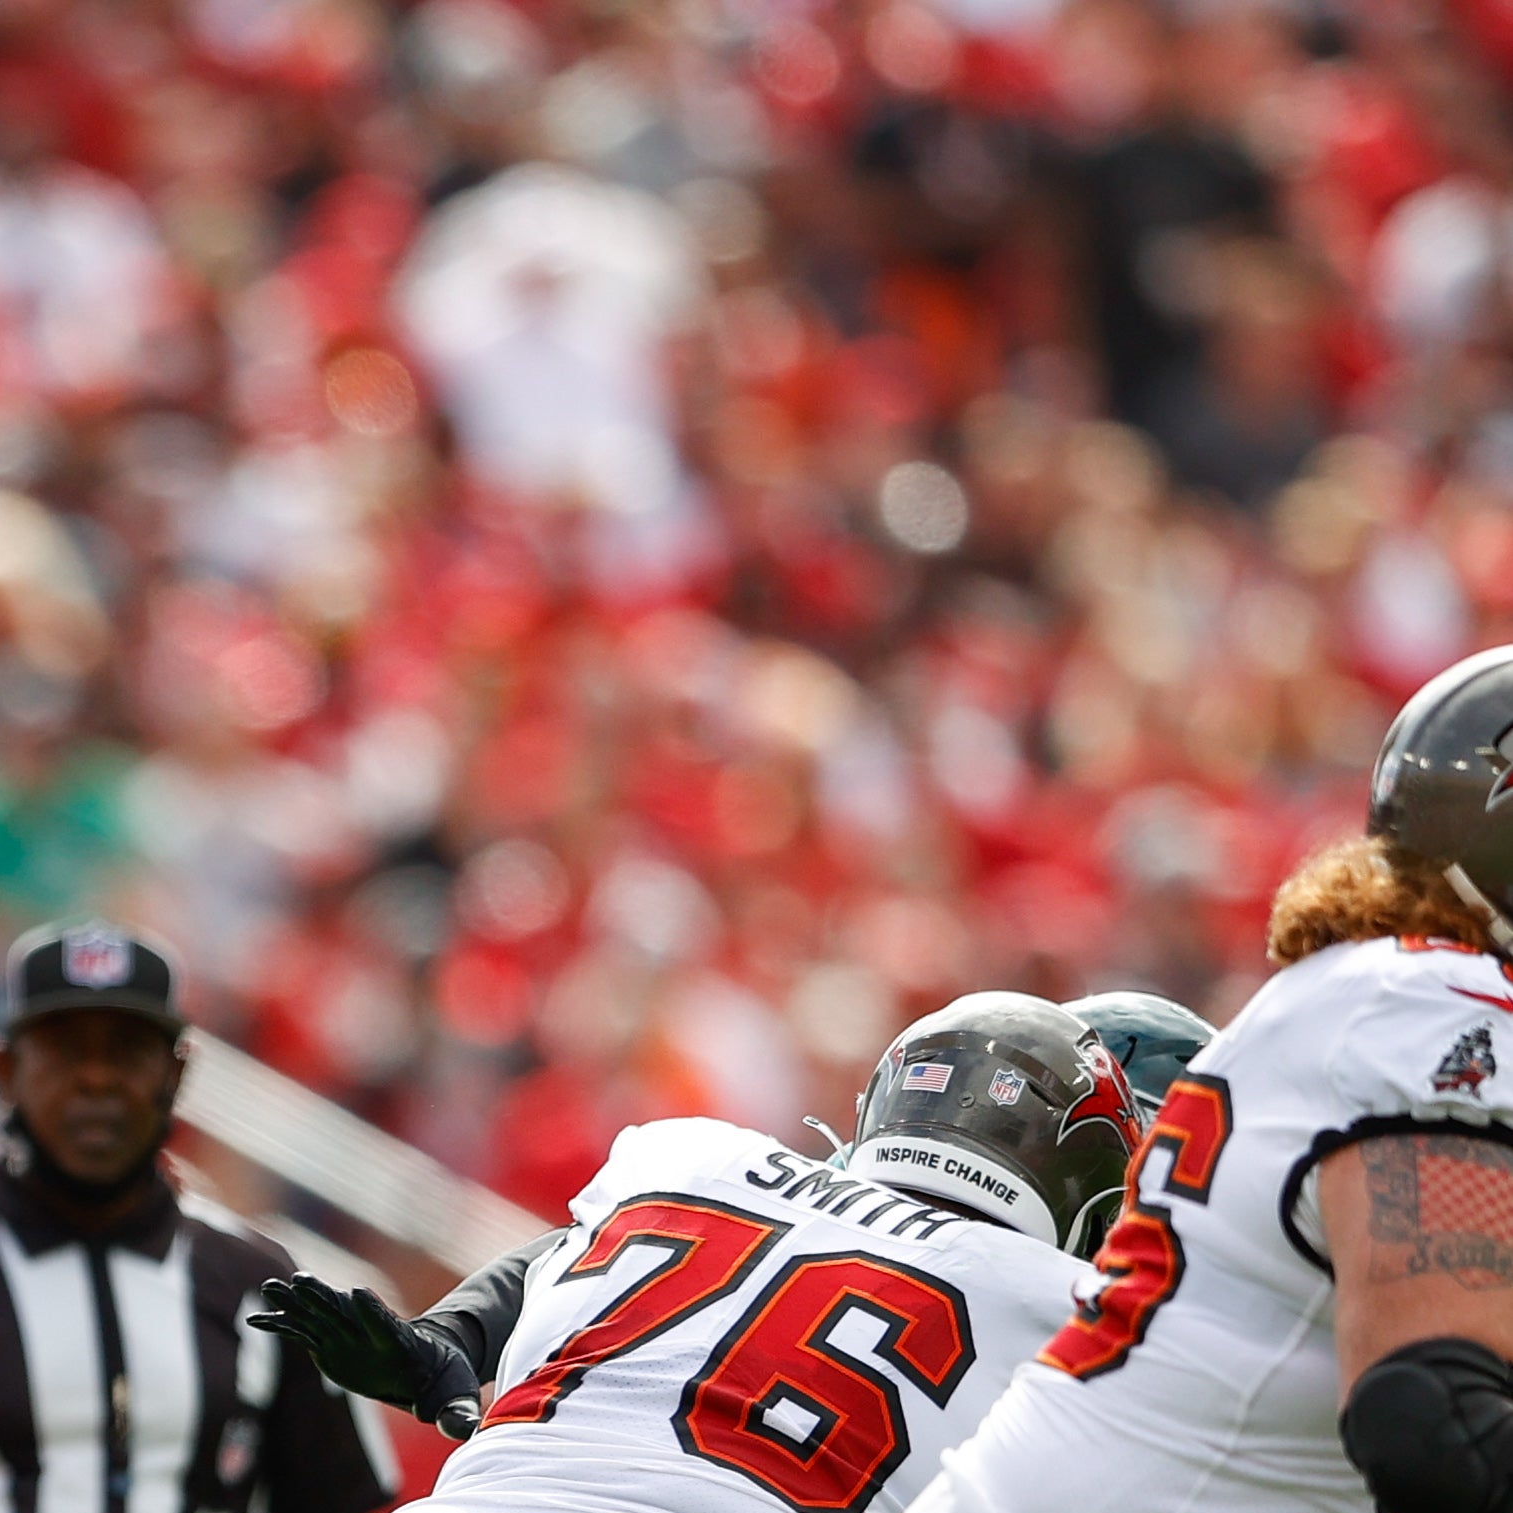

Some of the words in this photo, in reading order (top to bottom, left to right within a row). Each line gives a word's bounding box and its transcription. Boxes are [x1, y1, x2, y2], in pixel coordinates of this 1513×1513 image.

[745, 1151, 970, 1240] SMITH
[876, 1147, 941, 1170] INSPIRE
[944, 1158, 1020, 1206] CHANGE
